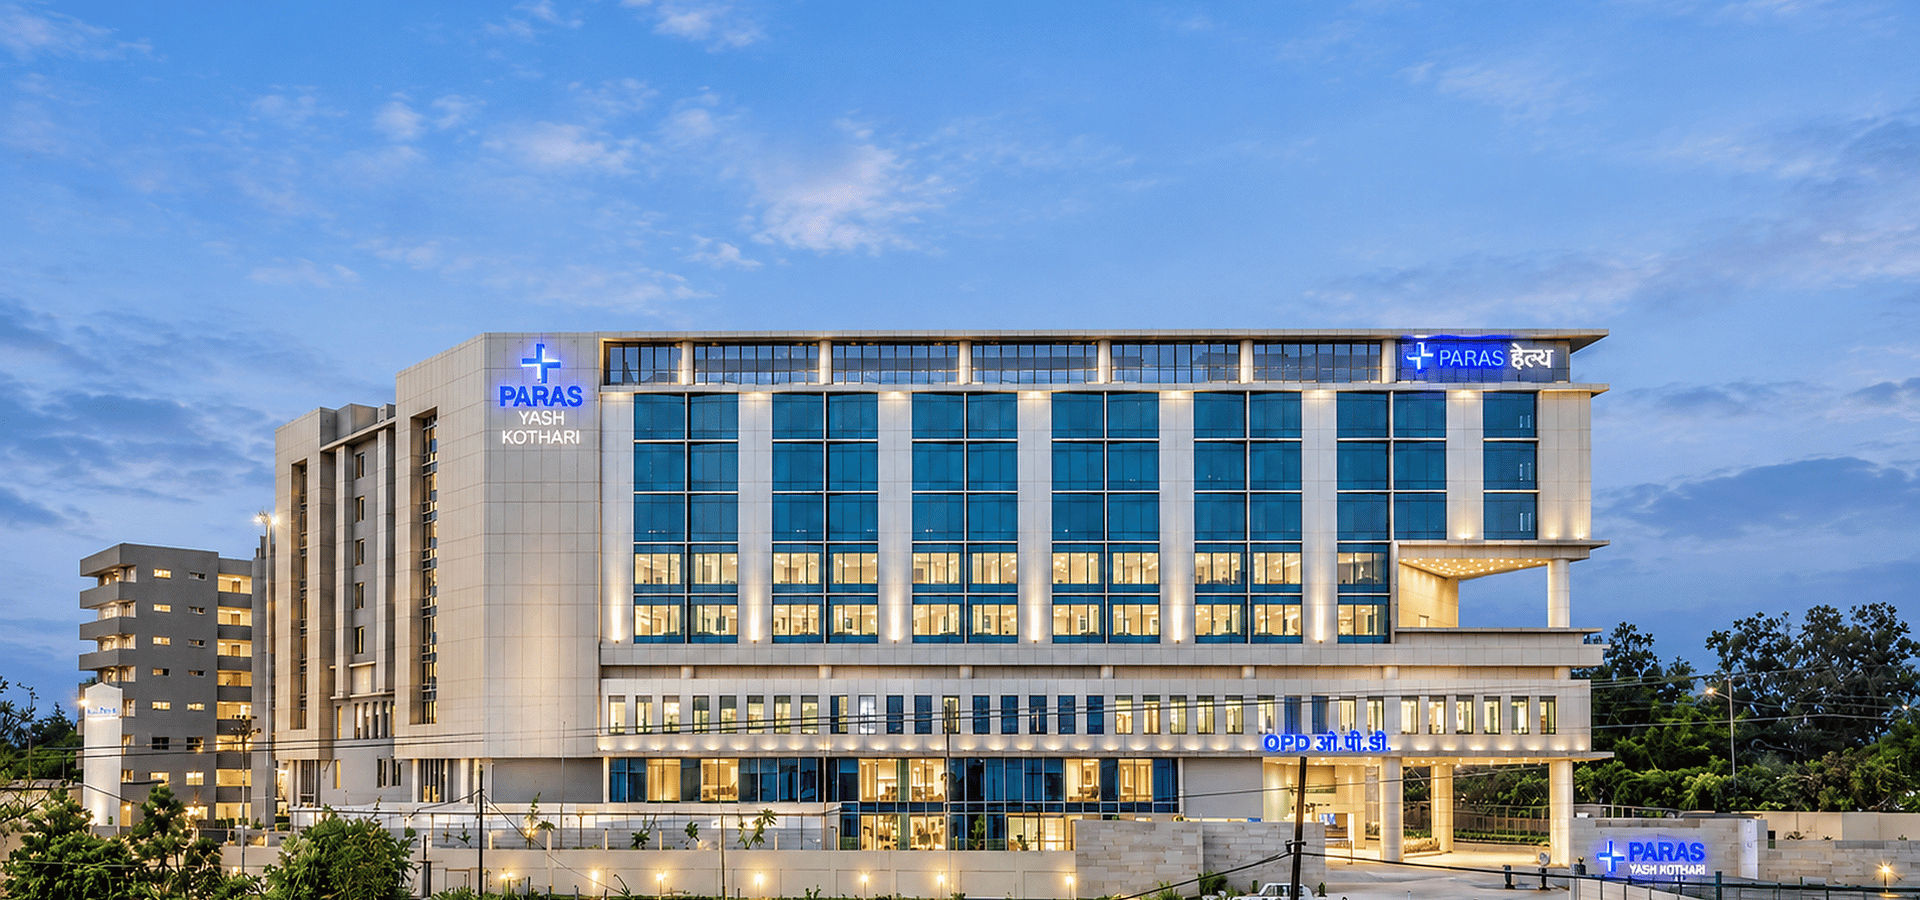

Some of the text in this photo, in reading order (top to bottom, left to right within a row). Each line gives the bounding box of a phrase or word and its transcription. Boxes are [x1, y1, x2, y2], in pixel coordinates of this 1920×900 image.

[1439, 349, 1504, 367] PARAS
[500, 386, 583, 407] PARAS
[518, 410, 565, 426] YASH
[501, 429, 580, 445] KOTHARI
[1263, 733, 1311, 752] OPD
[1628, 842, 1705, 862] PARAS
[1629, 863, 1657, 875] YASH
